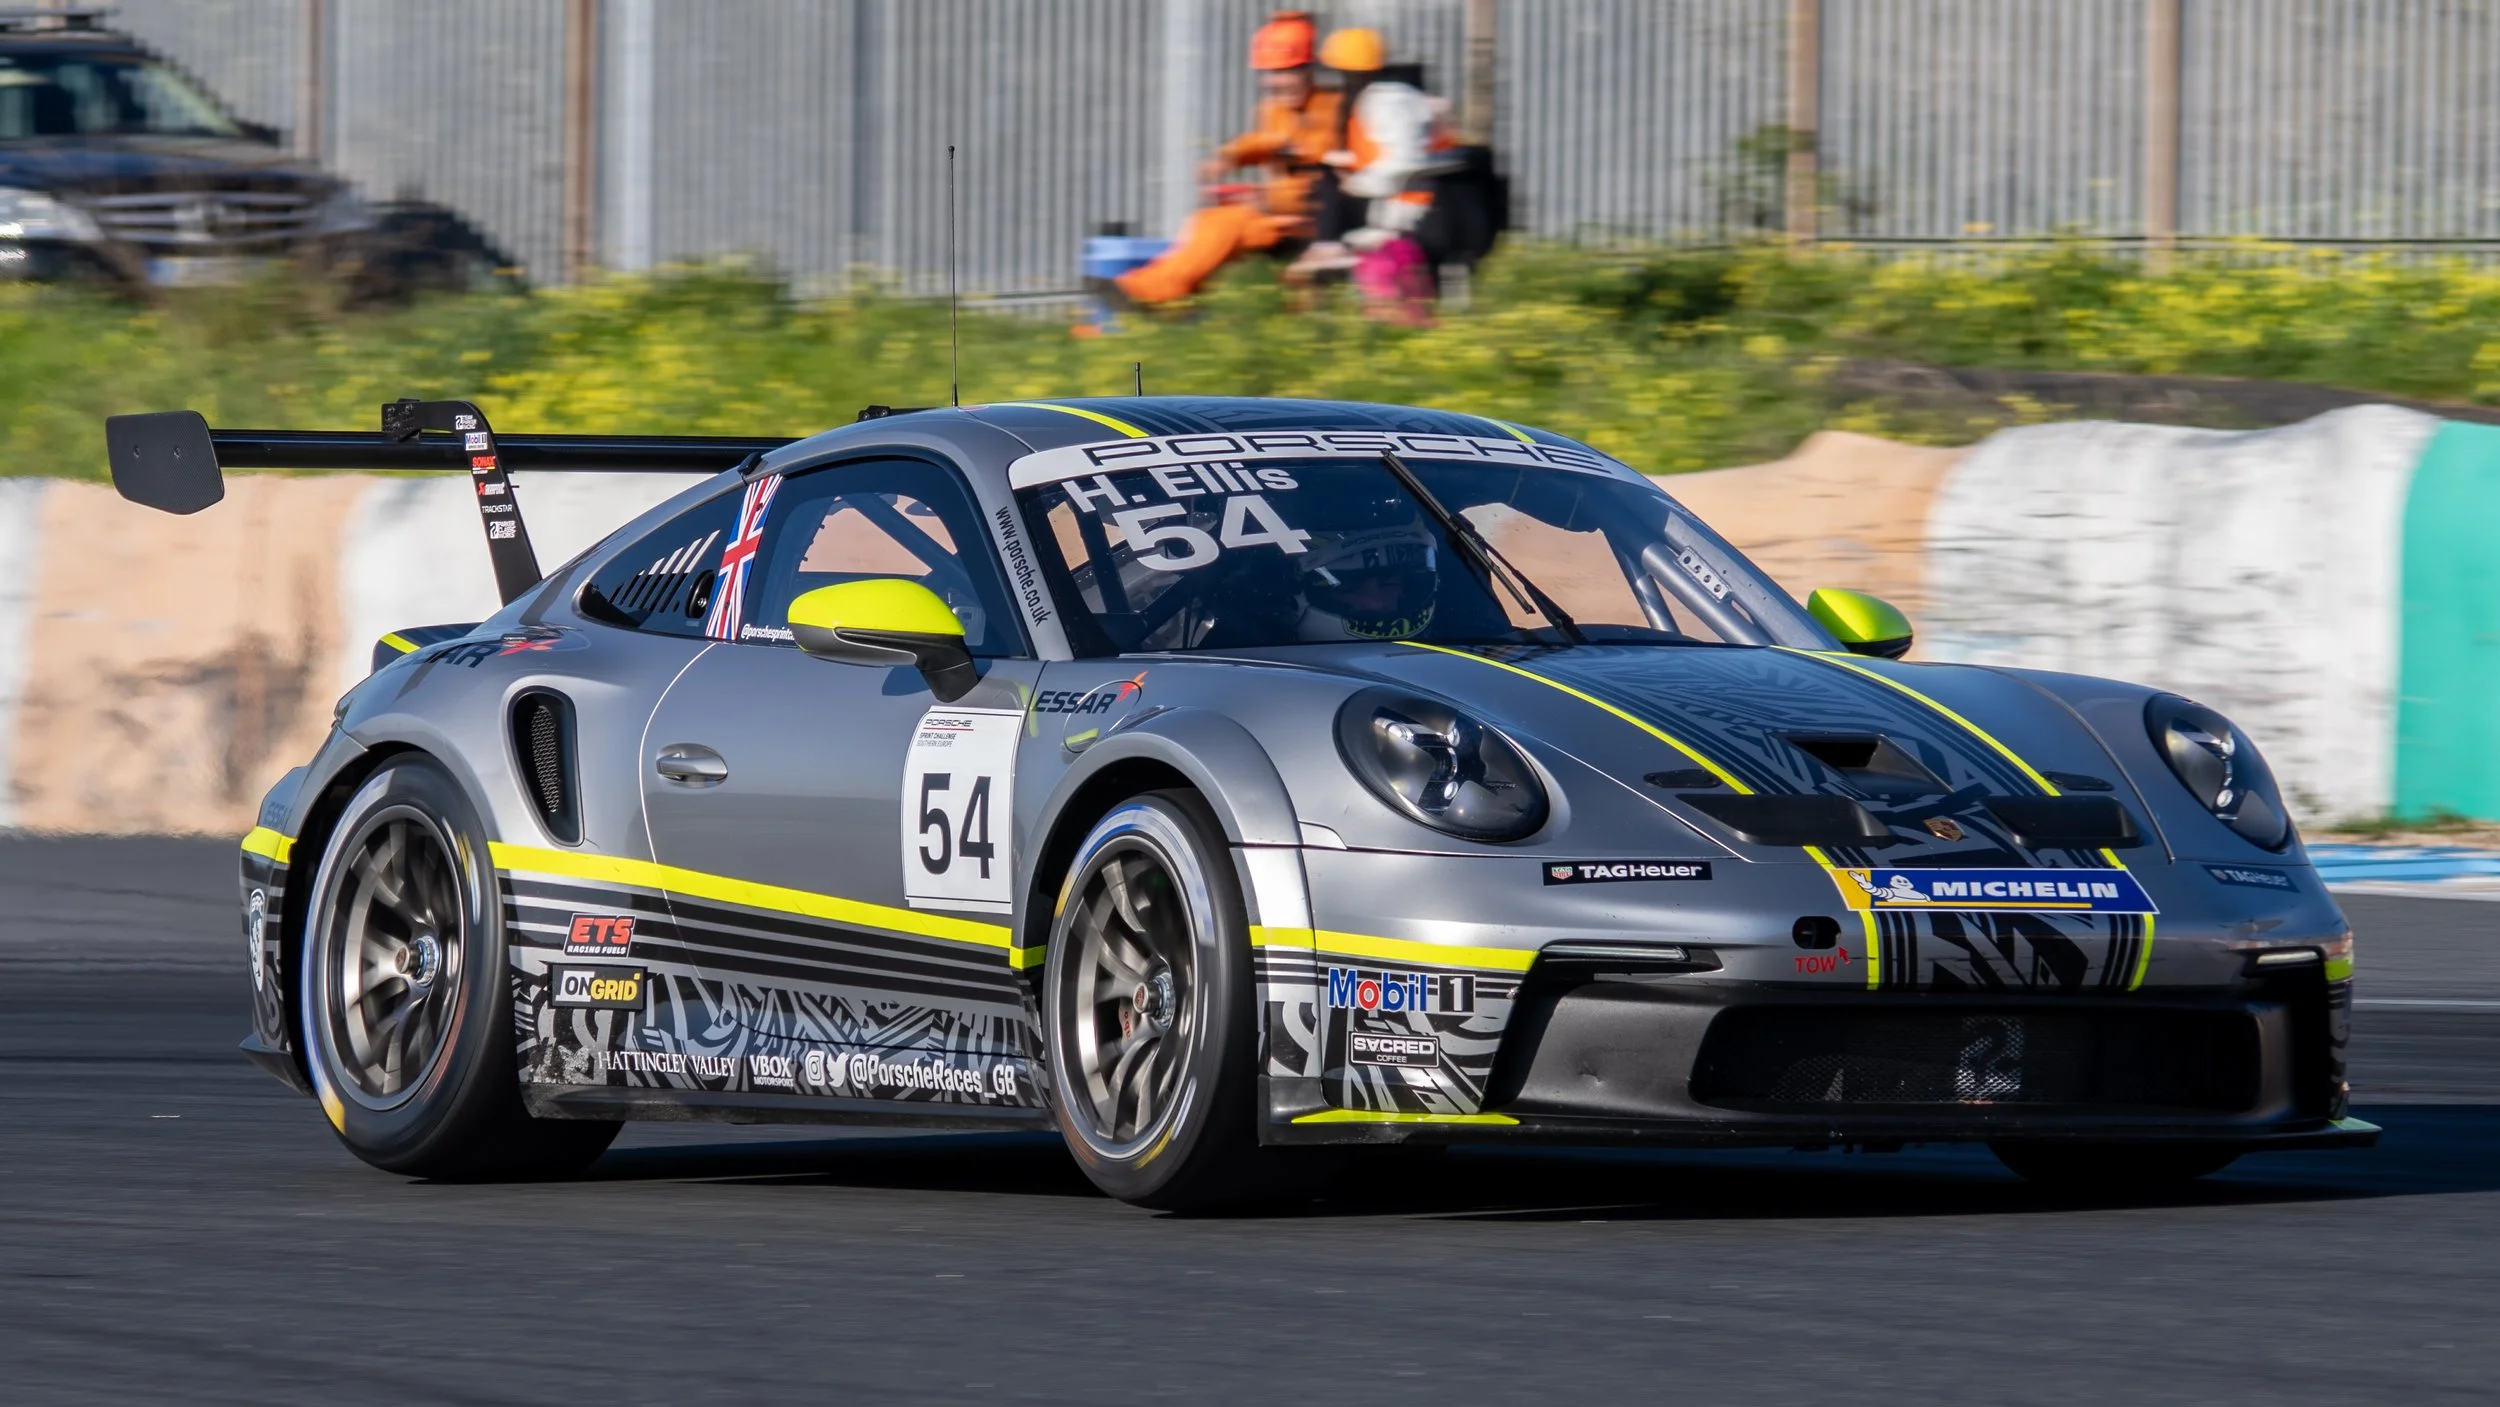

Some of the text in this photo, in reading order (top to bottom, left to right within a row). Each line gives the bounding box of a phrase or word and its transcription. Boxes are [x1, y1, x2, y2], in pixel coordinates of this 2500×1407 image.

[1081, 433, 1614, 475] PORSCHE
[1061, 461, 1299, 513] H. Ellis
[482, 504, 513, 514] TRACKSTAR
[1112, 494, 1312, 572] 54
[995, 506, 1051, 627] www.porsche.co.uk
[1032, 690, 1118, 714] ESSAR
[925, 718, 972, 727] PORSCHE
[916, 739, 953, 748] SOUTHERN EUROPE
[934, 732, 957, 740] CHALLENGE
[919, 773, 995, 879] 54
[1932, 881, 2119, 899] MICHELIN
[571, 917, 633, 945] ETS
[602, 946, 627, 955] FUELS
[1794, 956, 1837, 974] TOW
[1328, 967, 1428, 1013] Mobil
[598, 1051, 736, 1077] HATTINGLEY VALLEY
[749, 1055, 793, 1078] VBOX
[1376, 1055, 1407, 1063] COFFEE
[753, 1076, 794, 1087] MOTORSPORT
